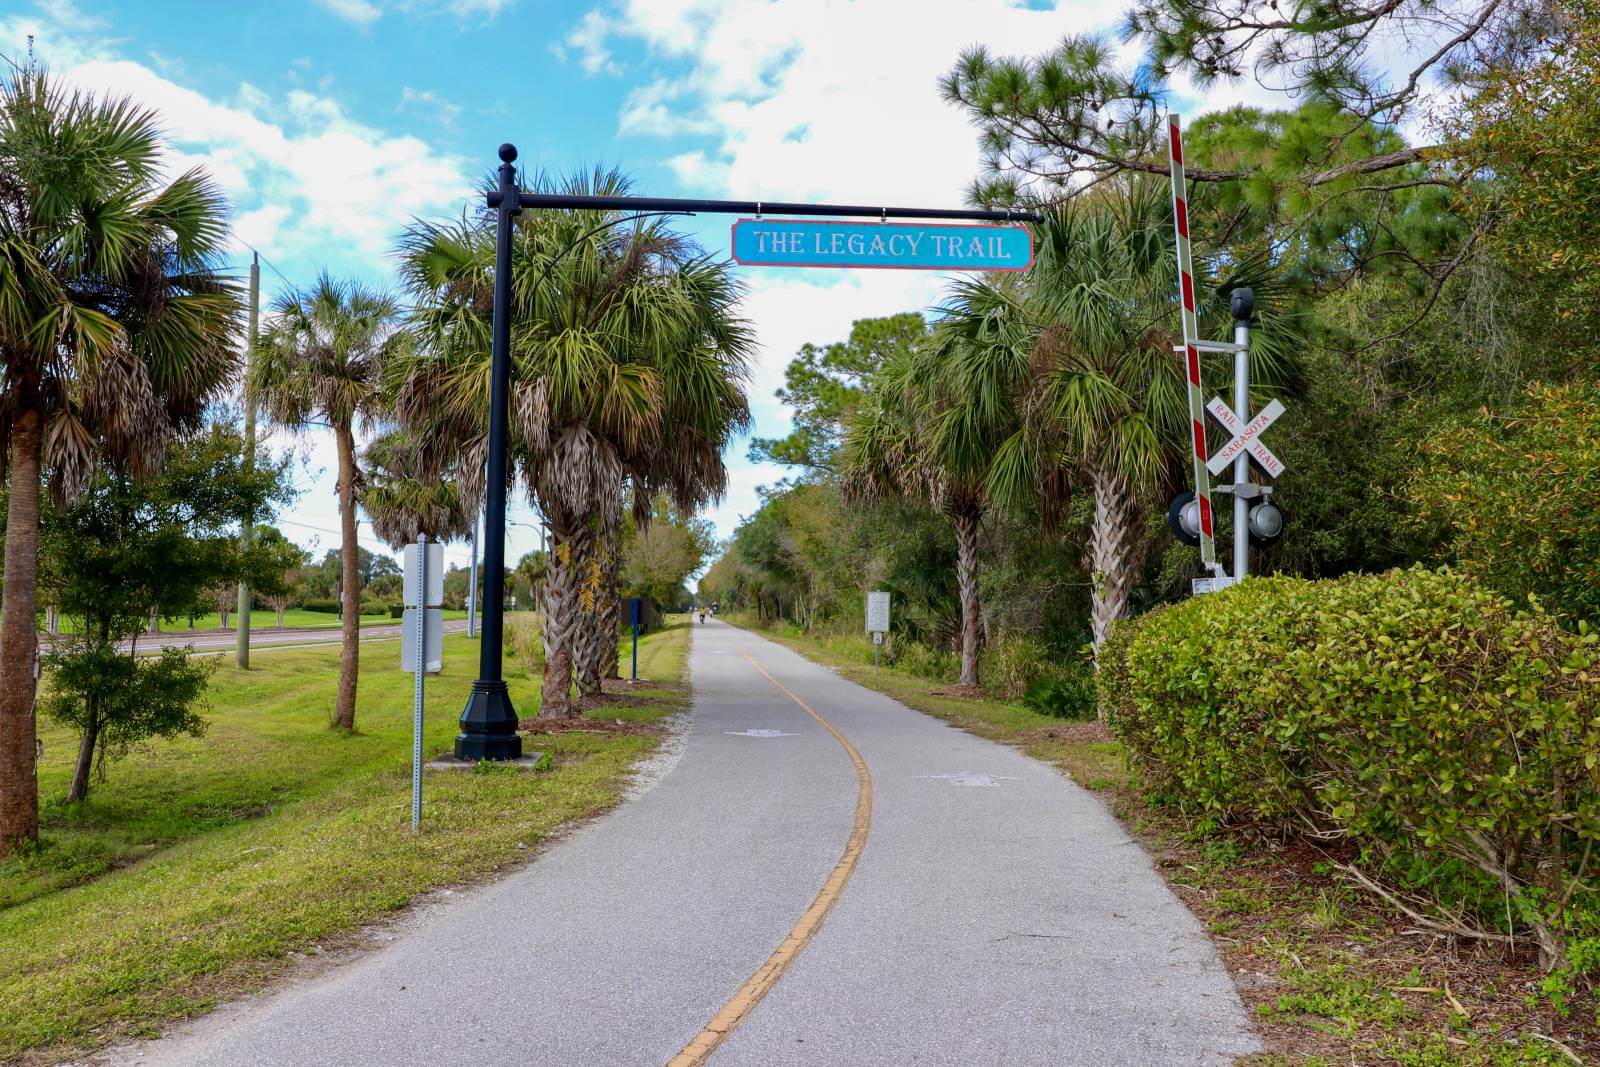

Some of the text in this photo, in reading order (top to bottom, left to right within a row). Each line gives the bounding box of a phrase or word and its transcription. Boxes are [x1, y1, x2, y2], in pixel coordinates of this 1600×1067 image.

[753, 231, 1011, 258] THE LEGACY TRAIL
[1215, 403, 1237, 428] RAIL
[1221, 415, 1270, 460] SARASOTA
[1253, 442, 1278, 472] TRAIL
